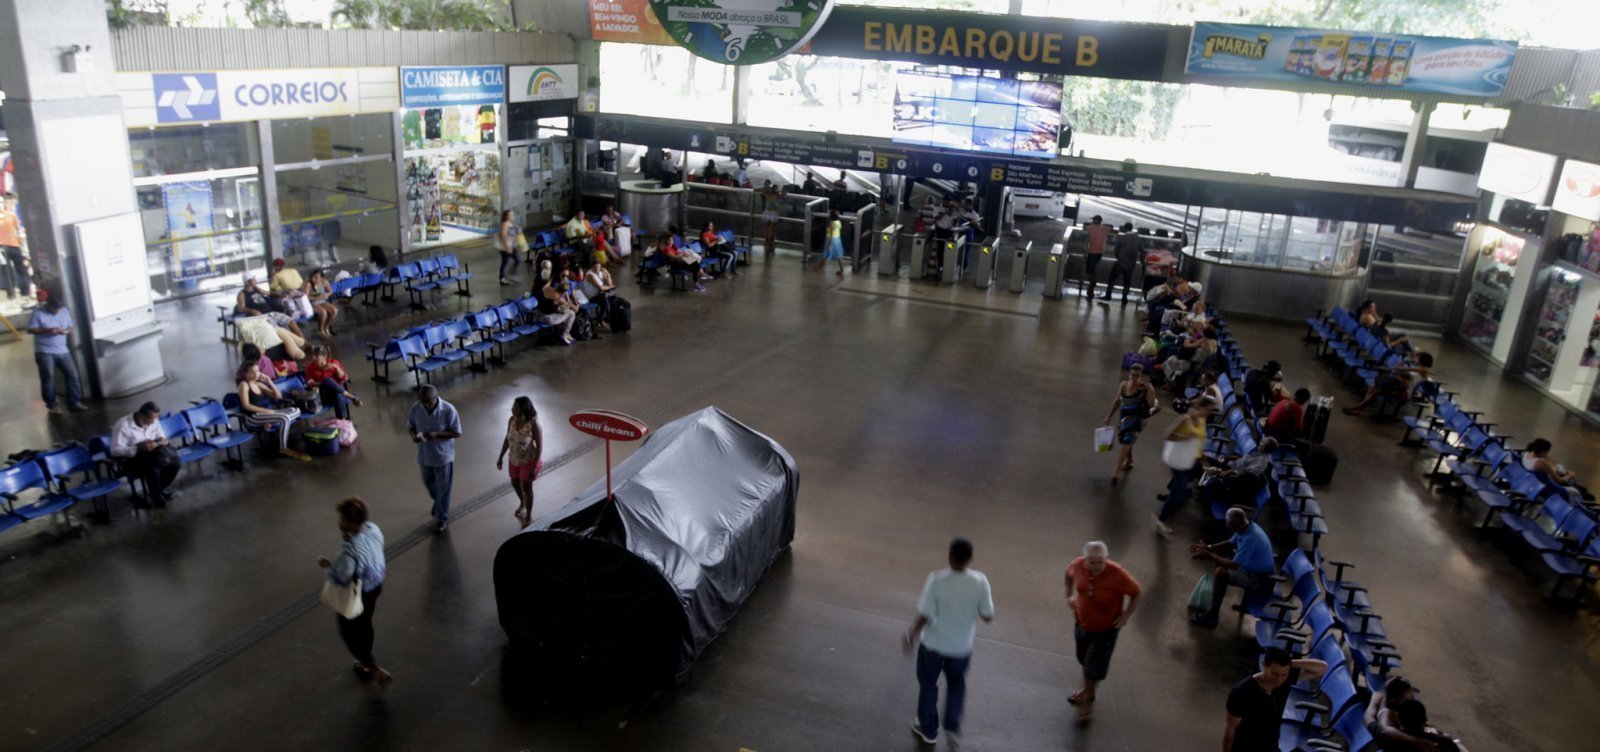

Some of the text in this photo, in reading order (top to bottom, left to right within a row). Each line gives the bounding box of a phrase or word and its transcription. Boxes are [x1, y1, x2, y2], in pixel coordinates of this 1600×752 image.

[592, 3, 609, 11] MEU
[594, 13, 637, 24] BEM-VINDO
[678, 10, 699, 19] Nossa
[701, 11, 728, 21] MODA
[729, 13, 755, 24] abraça
[725, 37, 742, 61] 6
[864, 21, 1099, 67] EMBARQUE B
[1424, 60, 1445, 71] para
[404, 69, 503, 89] CAMISETA & CIA
[234, 81, 348, 107] CORREIOS
[738, 142, 748, 155] B
[876, 156, 888, 168] B
[991, 167, 1004, 181] B
[576, 420, 636, 437] chilli beans
